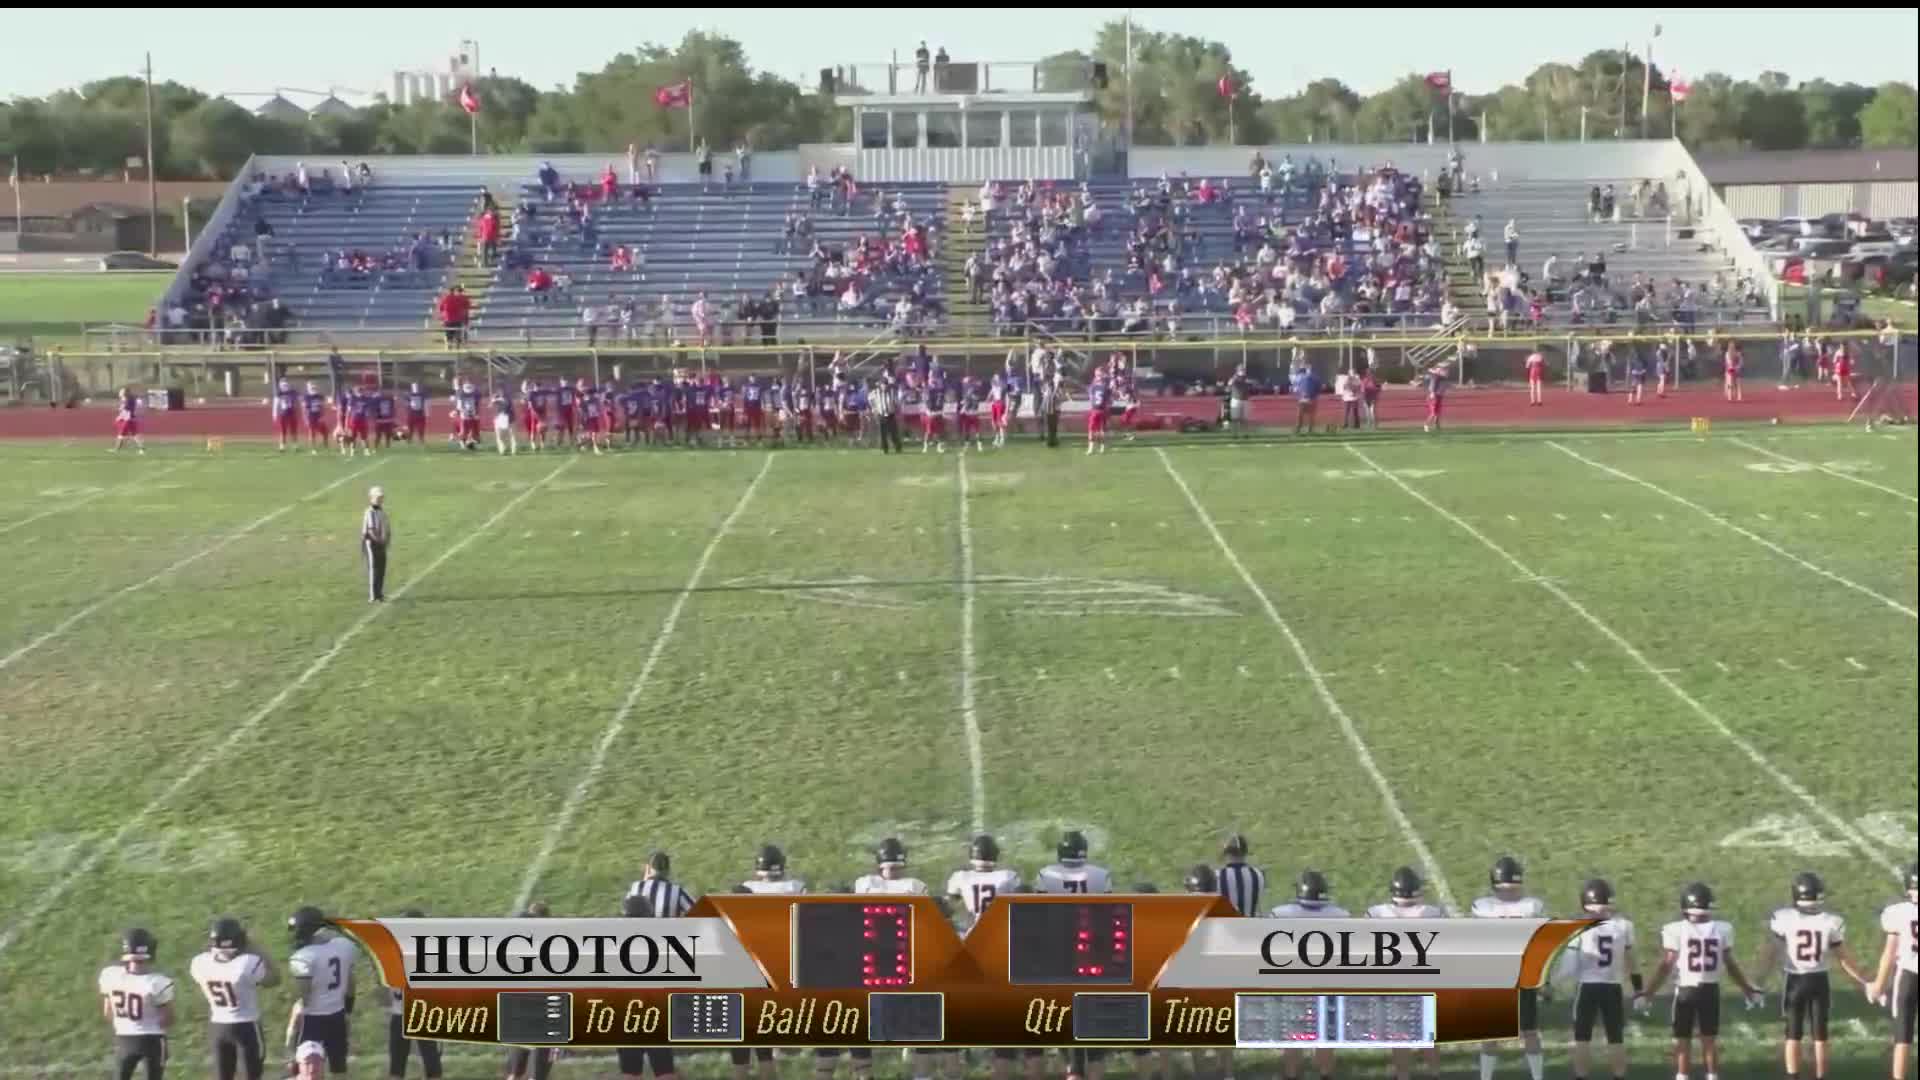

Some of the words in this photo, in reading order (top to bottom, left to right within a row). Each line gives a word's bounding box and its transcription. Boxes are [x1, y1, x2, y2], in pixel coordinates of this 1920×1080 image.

[973, 884, 996, 913] 12
[1596, 936, 1614, 967] 5
[1687, 938, 1719, 973] 25
[1795, 929, 1823, 962] 21
[327, 956, 342, 990] 3
[111, 990, 144, 1022] 20
[206, 980, 239, 1008] 51
